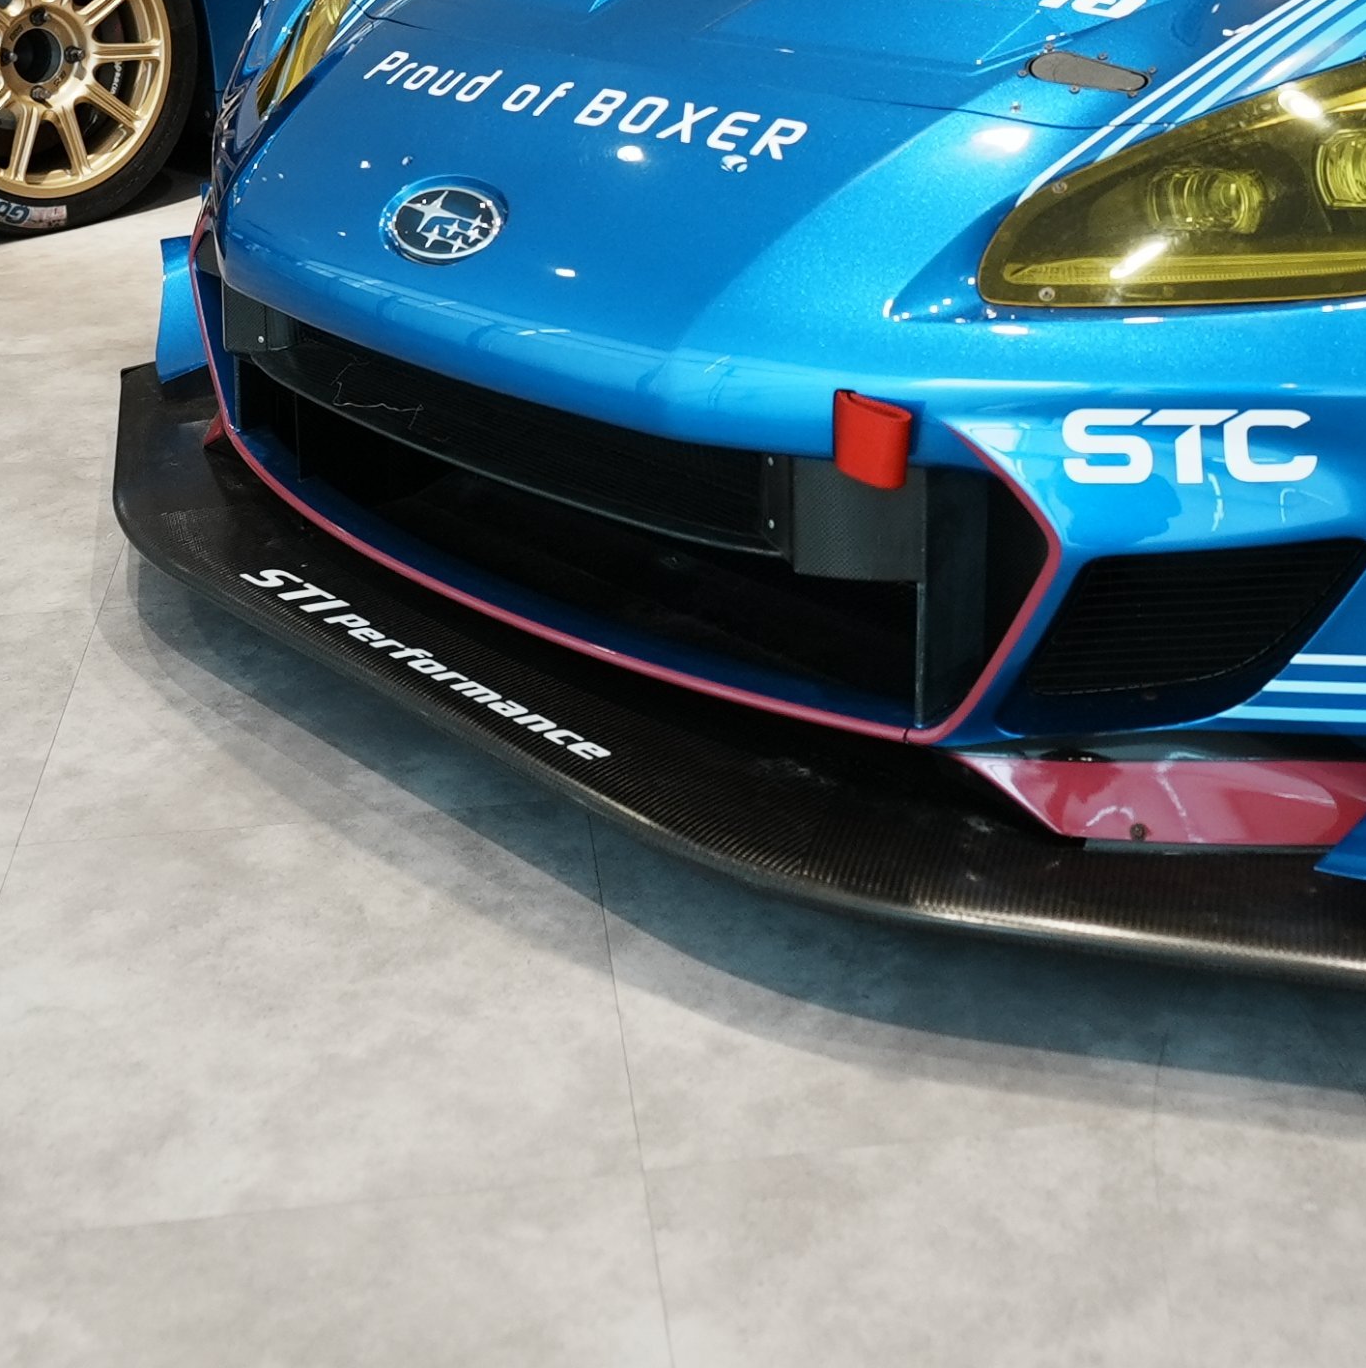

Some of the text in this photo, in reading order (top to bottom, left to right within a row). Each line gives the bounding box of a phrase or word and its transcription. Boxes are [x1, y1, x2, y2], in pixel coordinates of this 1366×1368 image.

[363, 49, 808, 161] Proud of BOXER
[1062, 408, 1318, 484] STC
[240, 568, 612, 762] STI Performance
